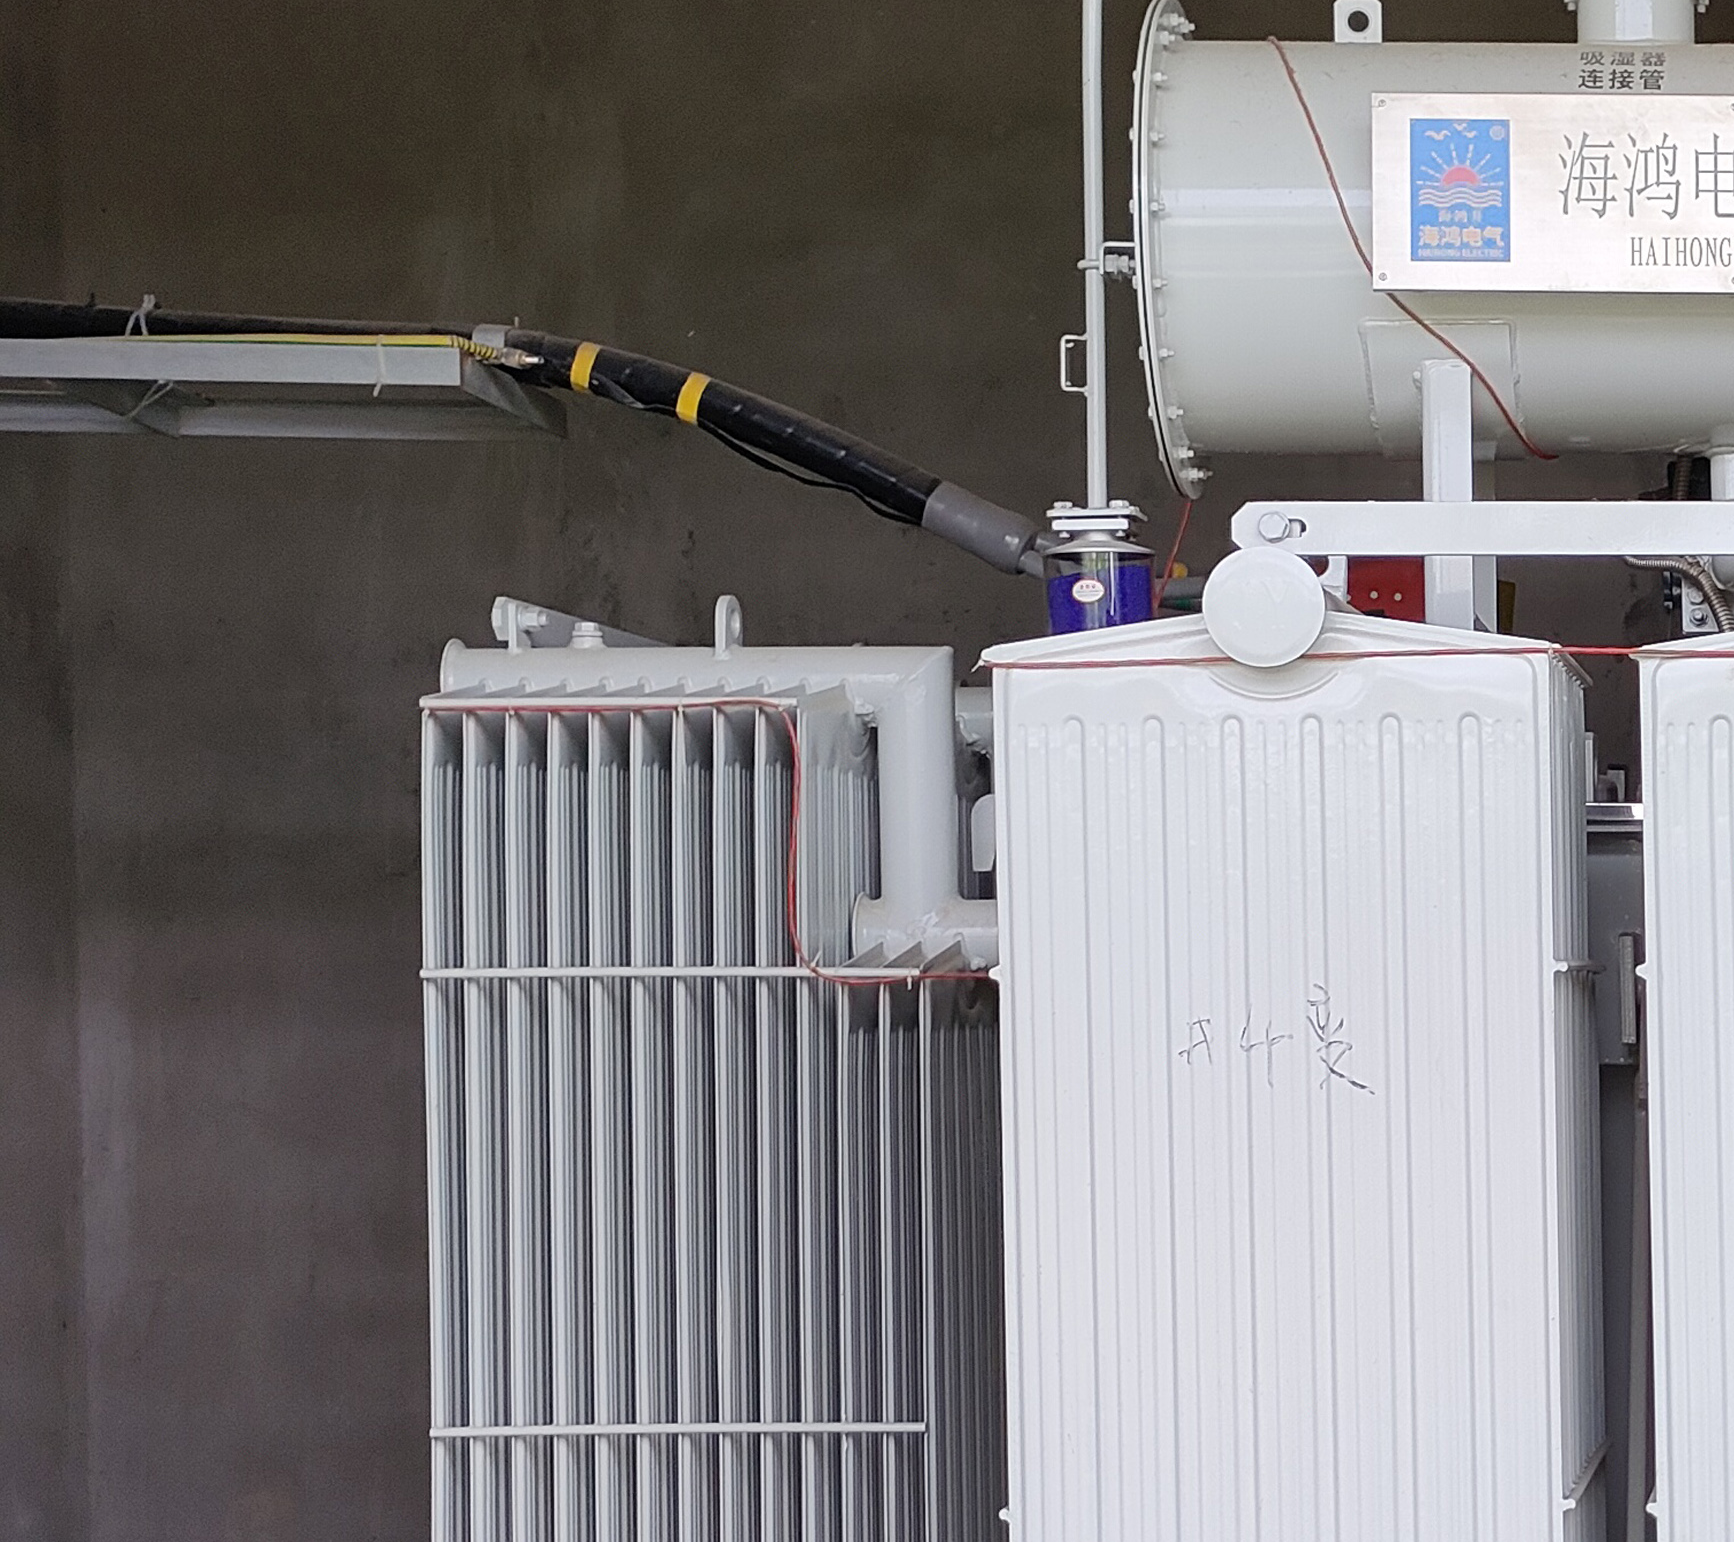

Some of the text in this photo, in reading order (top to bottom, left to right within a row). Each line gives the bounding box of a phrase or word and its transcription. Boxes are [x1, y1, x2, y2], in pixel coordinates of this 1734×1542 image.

[1580, 51, 1666, 66] 吸湿器
[1578, 68, 1665, 90] 连接管
[1418, 225, 1505, 246] 海鸿电气
[1630, 236, 1732, 269] HAIHONG
